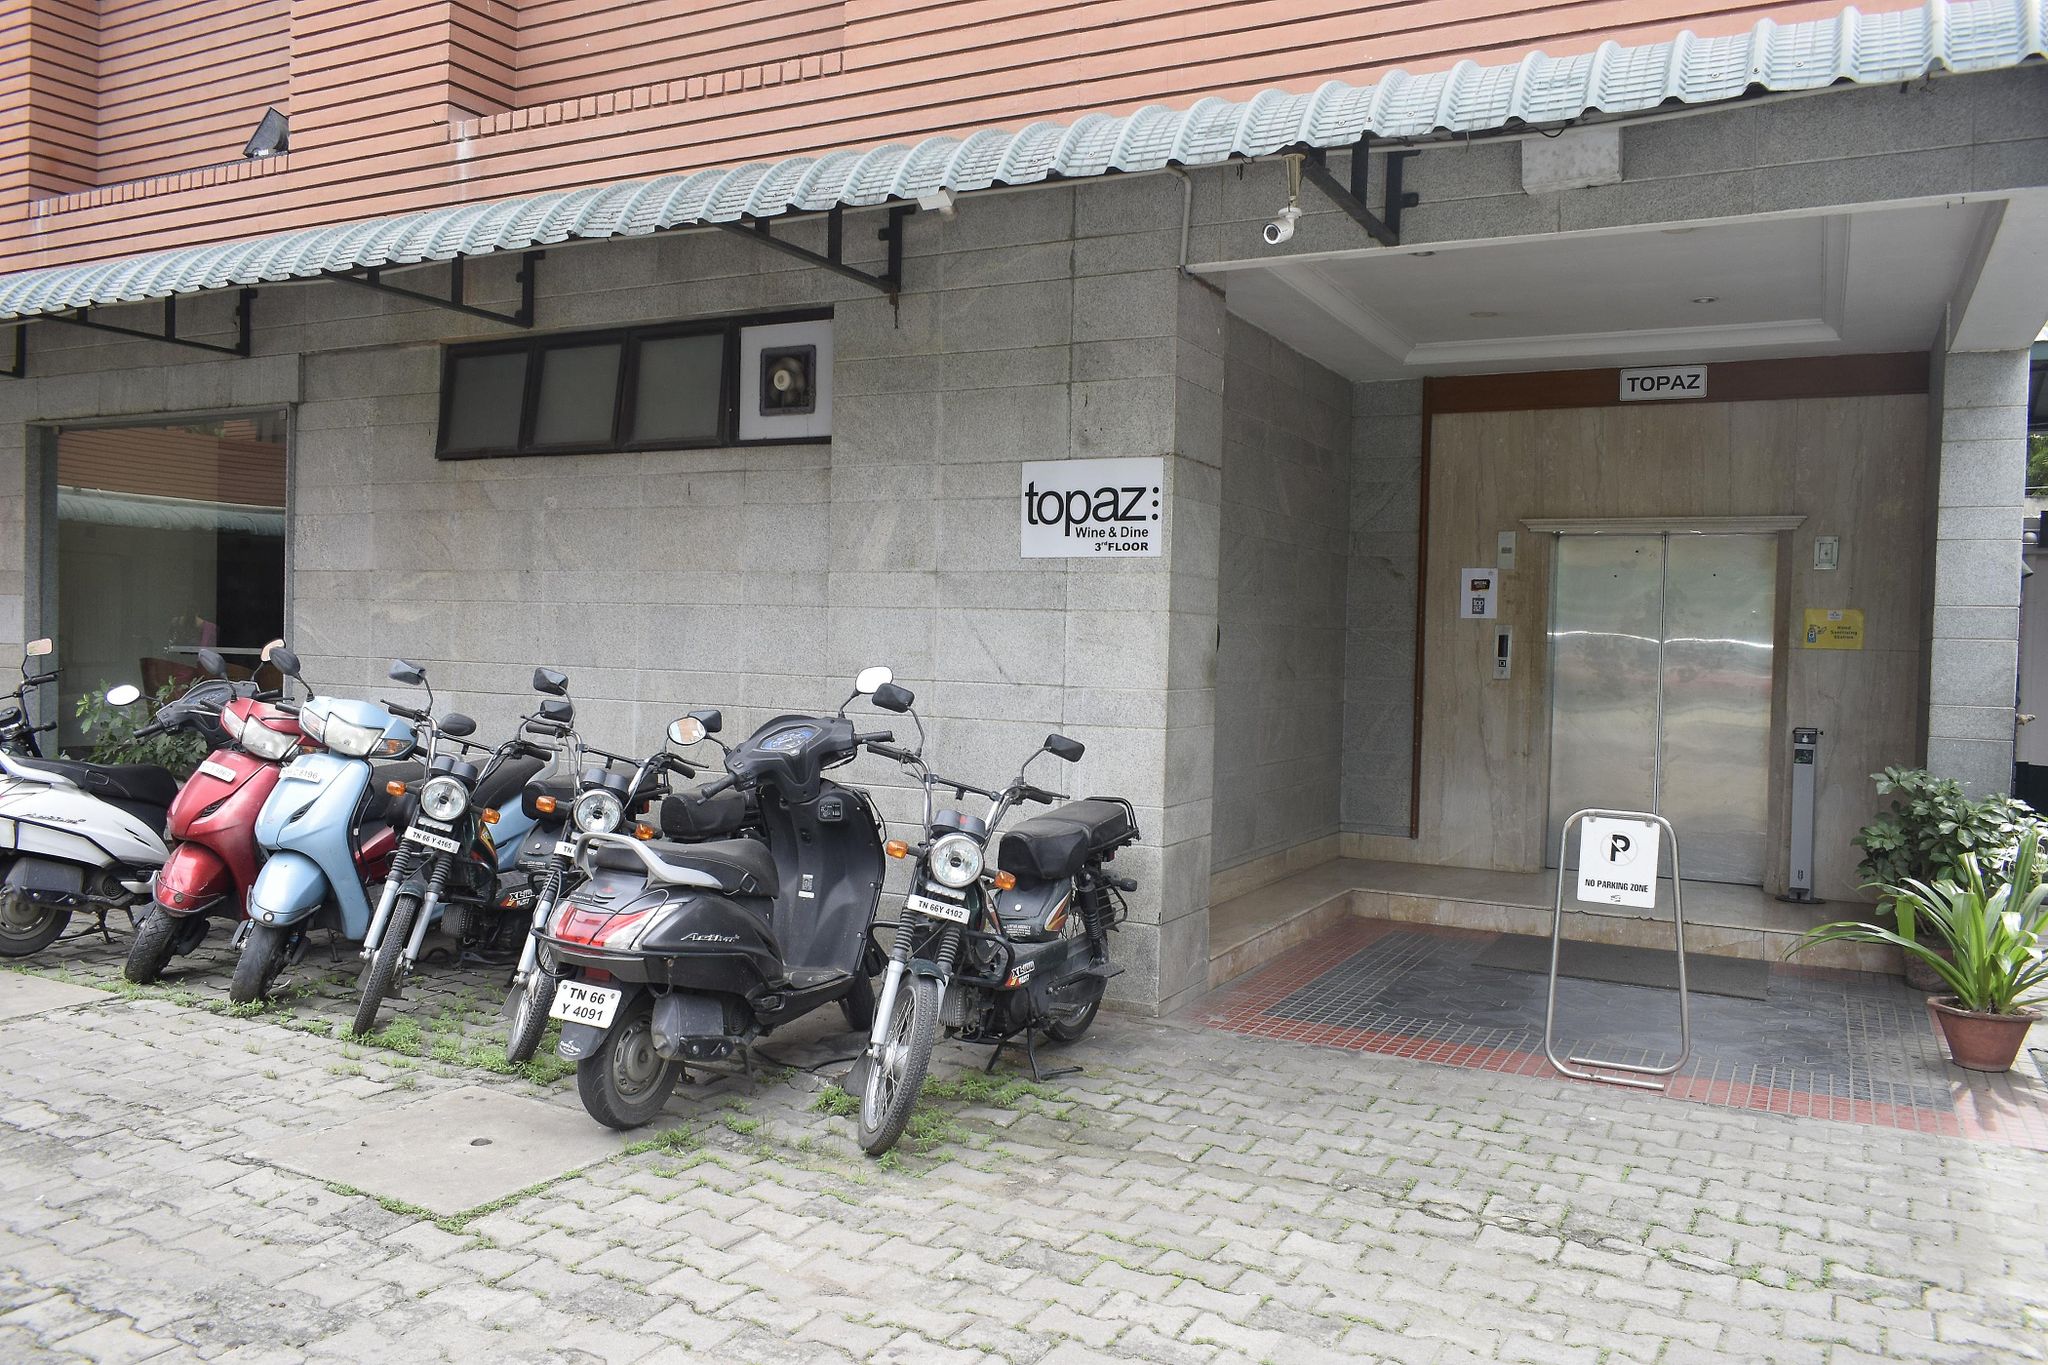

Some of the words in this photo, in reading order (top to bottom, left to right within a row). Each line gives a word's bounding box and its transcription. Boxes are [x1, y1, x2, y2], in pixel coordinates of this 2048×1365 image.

[1626, 374, 1701, 392] TOPAZ
[1075, 526, 1106, 538] Wine
[1109, 526, 1118, 538] &
[1120, 526, 1149, 538] Dine
[1108, 542, 1149, 552] FLOOR
[412, 831, 422, 839] TN
[563, 845, 574, 854] TN
[1584, 878, 1595, 887] NO
[1596, 880, 1629, 891] PARKING
[1630, 883, 1649, 893] ZONE
[918, 900, 929, 909] TN
[945, 908, 964, 919] 4102
[569, 987, 588, 1001] TN
[589, 992, 606, 1005] 66
[561, 1003, 571, 1014] Y
[572, 1006, 604, 1021] 4091
